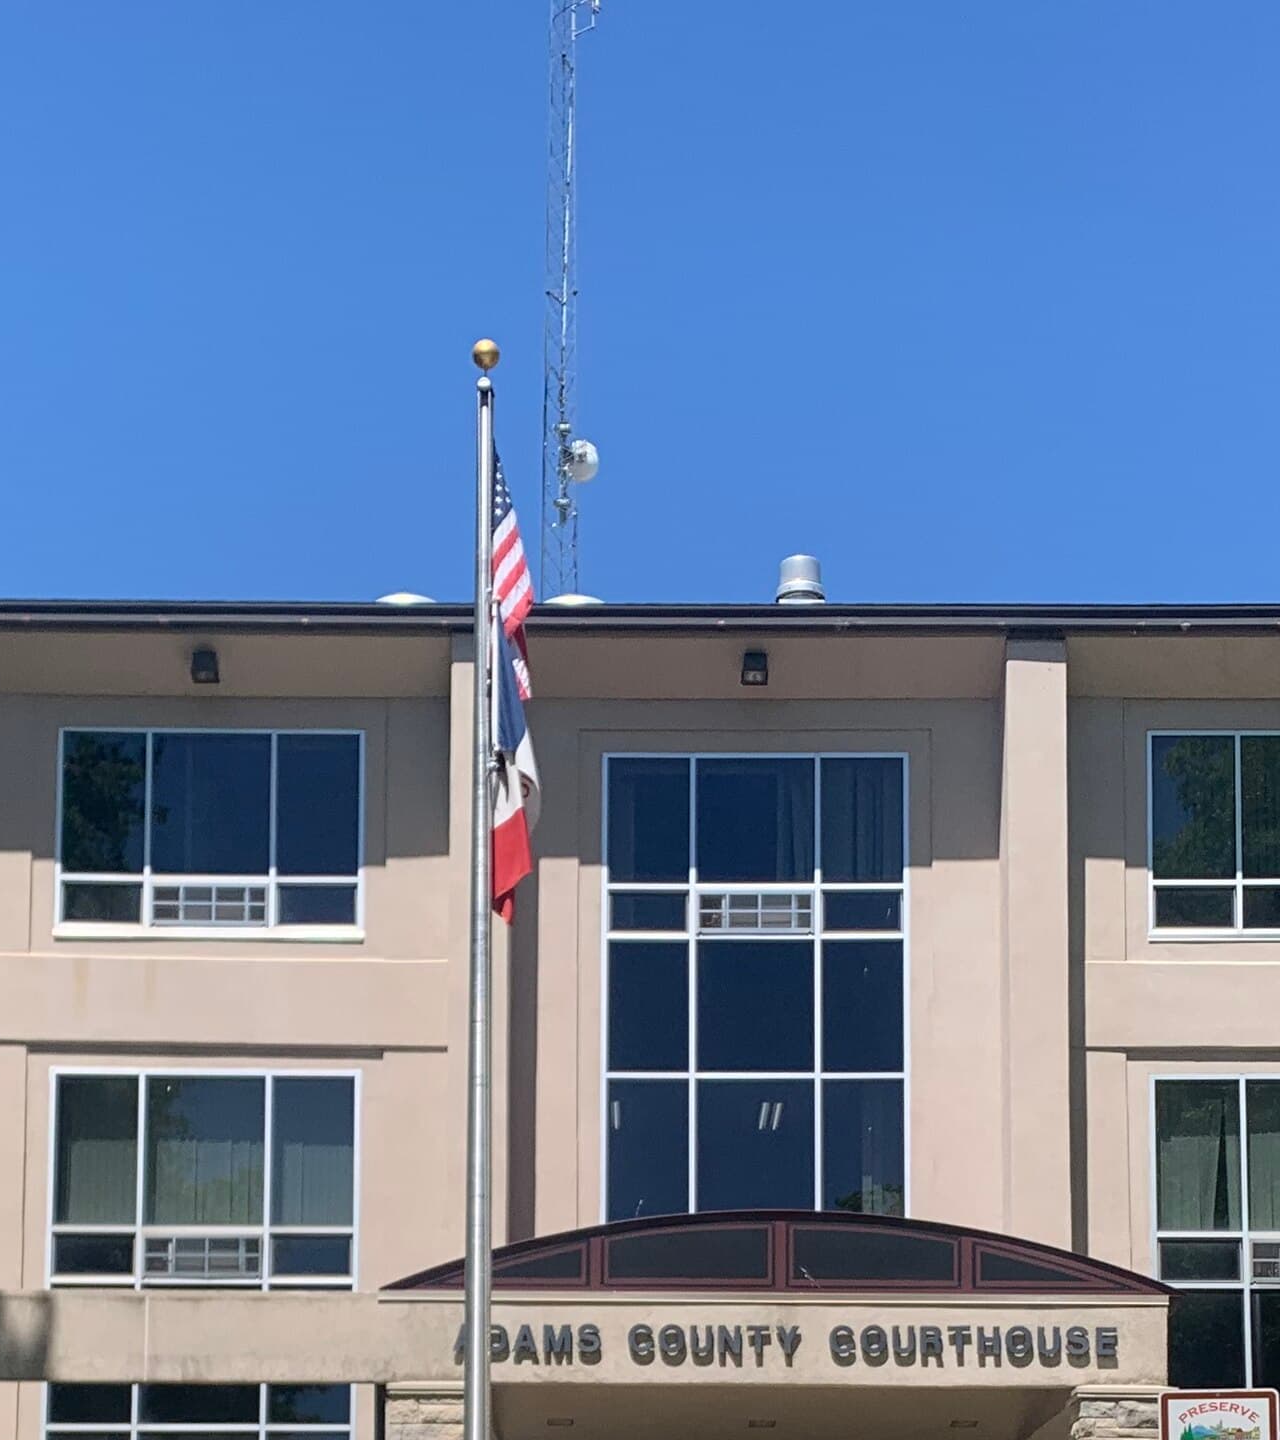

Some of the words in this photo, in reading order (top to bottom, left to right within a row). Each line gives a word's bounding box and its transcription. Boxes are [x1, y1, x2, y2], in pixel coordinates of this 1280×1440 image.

[627, 1324, 801, 1357] COUNTY
[829, 1324, 1119, 1357] COURTHOUSE
[1178, 1401, 1260, 1424] PRESERVE
